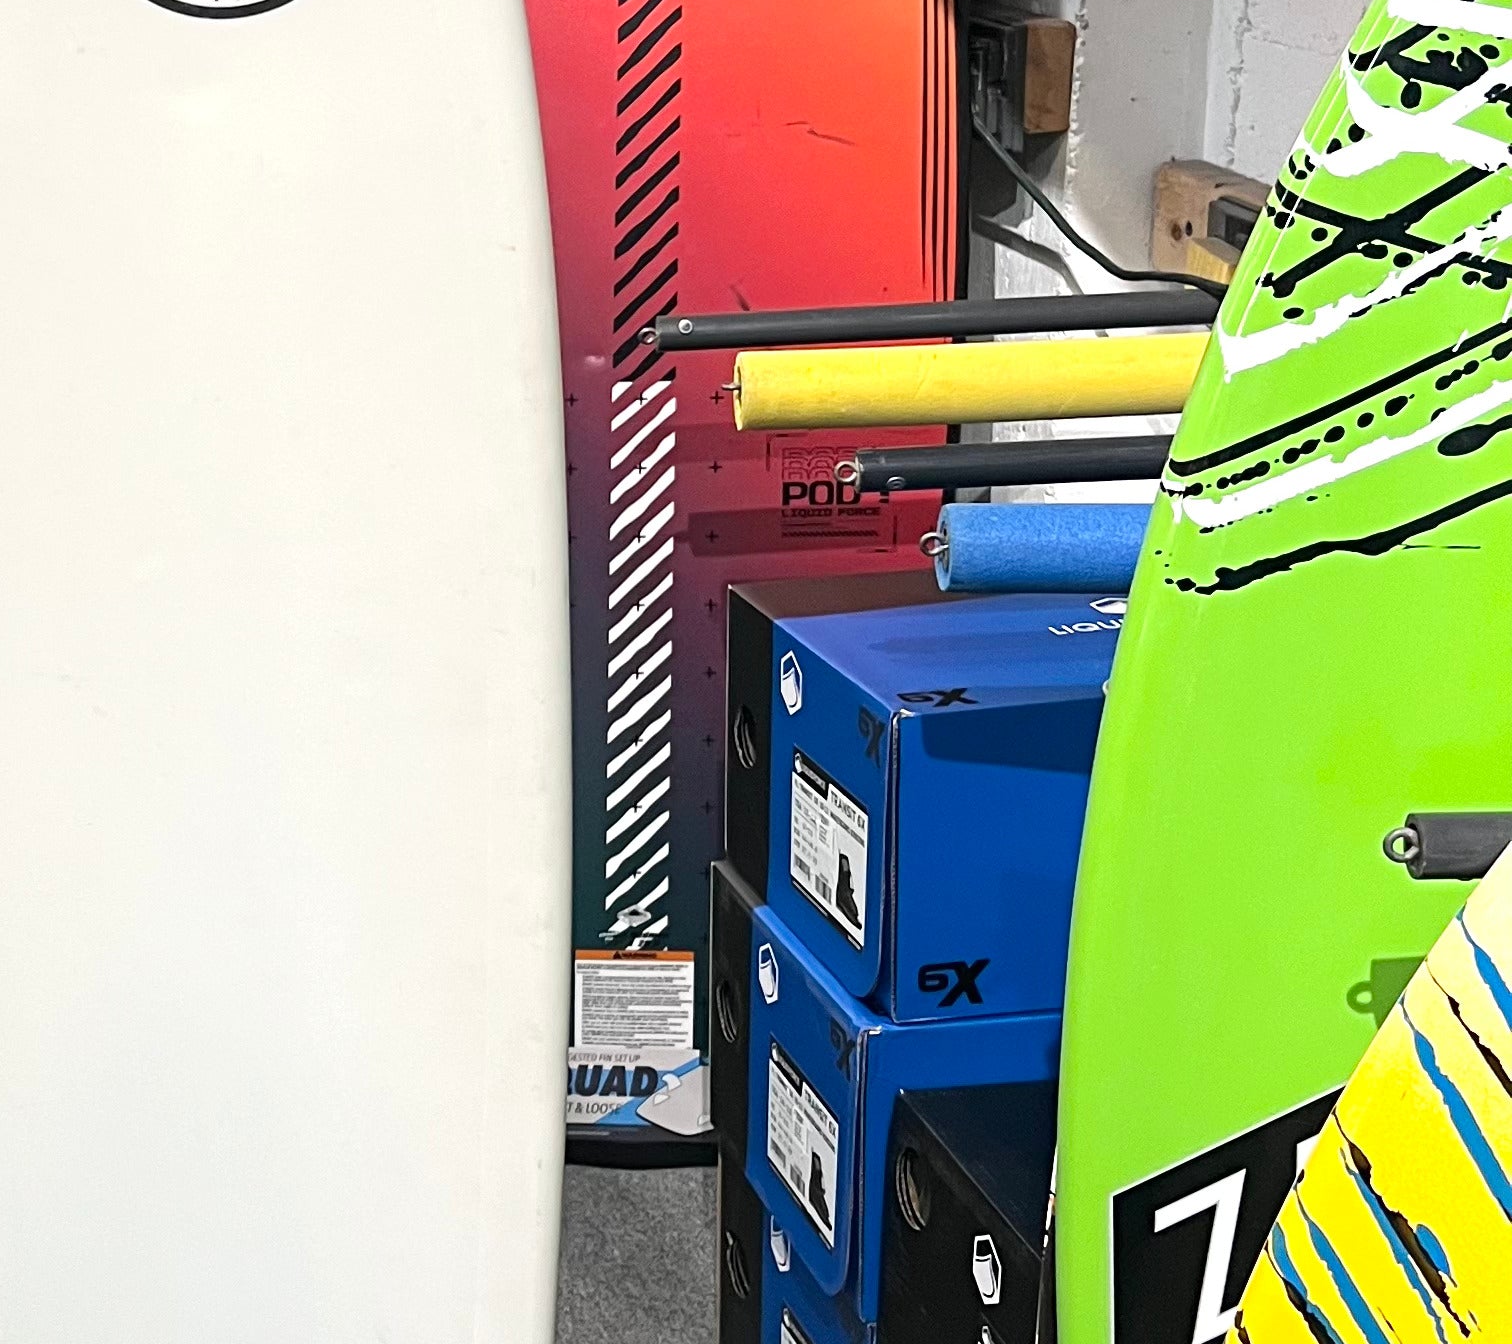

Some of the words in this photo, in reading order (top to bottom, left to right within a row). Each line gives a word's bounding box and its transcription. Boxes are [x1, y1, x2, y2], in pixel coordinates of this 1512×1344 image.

[782, 481, 861, 506] POD
[1048, 619, 1124, 635] LIQU
[917, 959, 991, 1008] 6X
[575, 1102, 585, 1114] &
